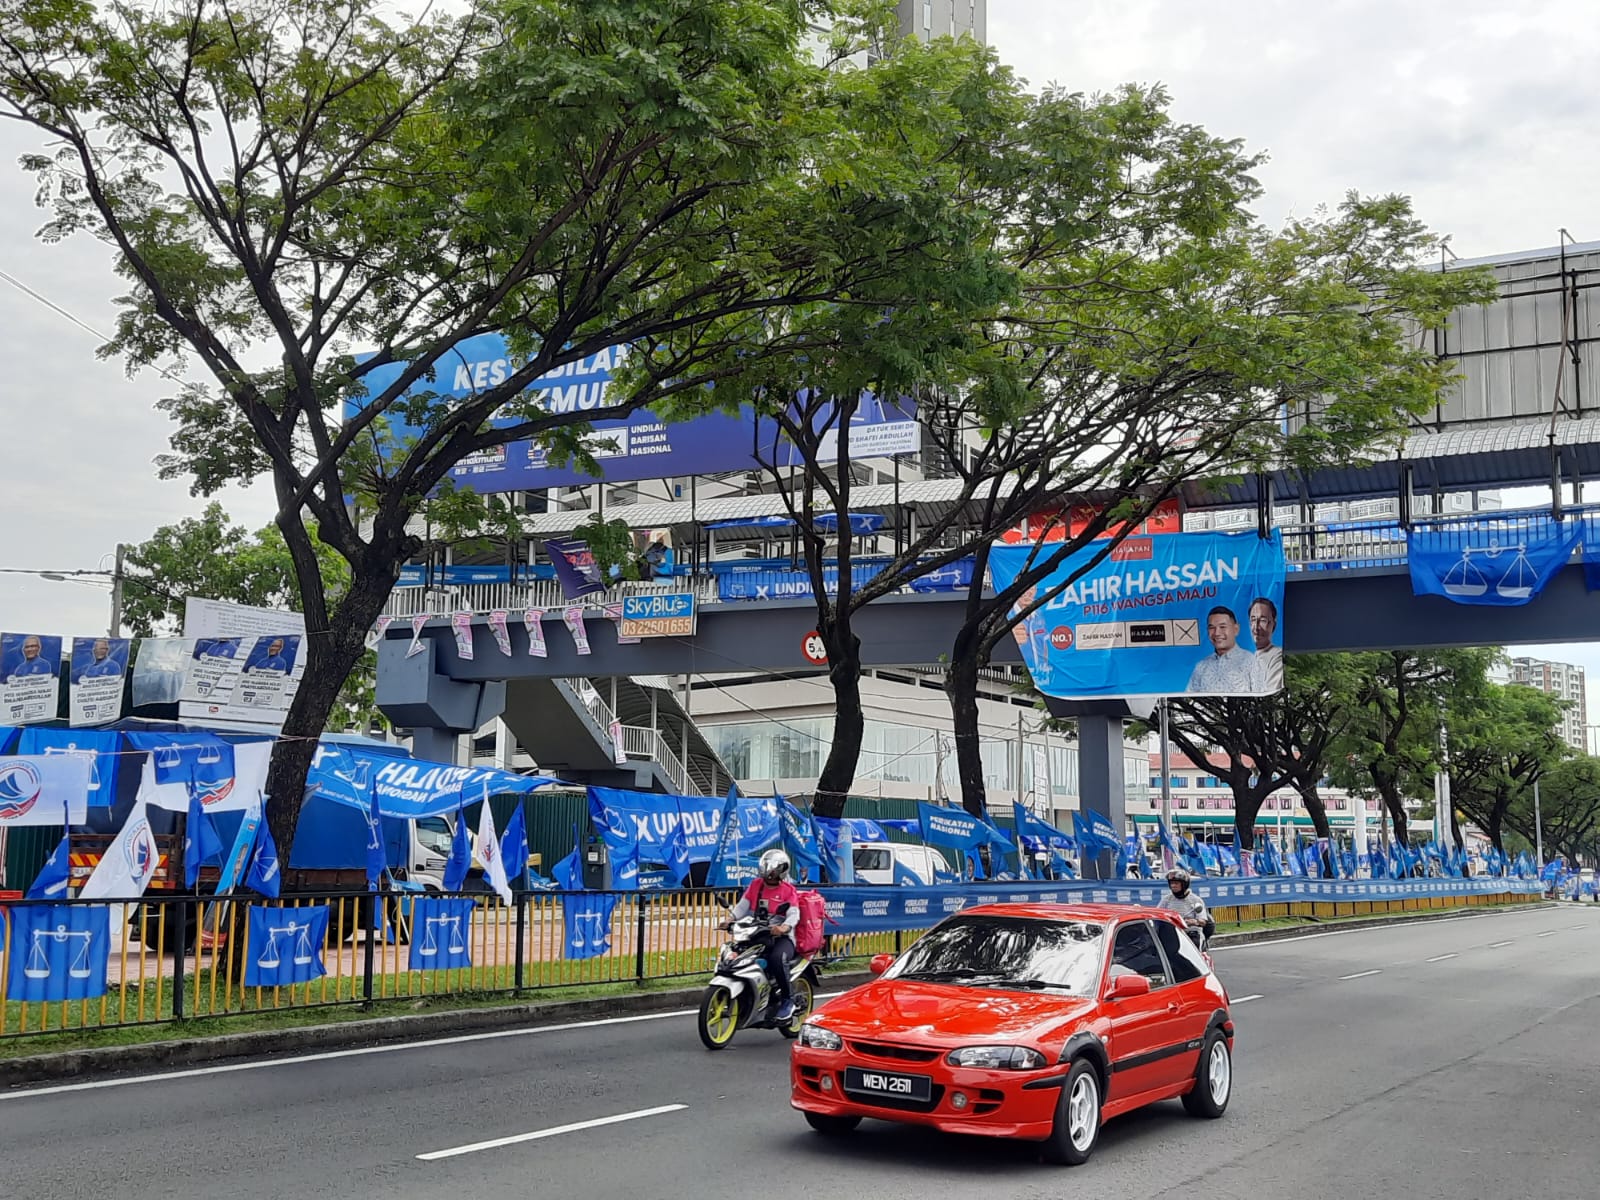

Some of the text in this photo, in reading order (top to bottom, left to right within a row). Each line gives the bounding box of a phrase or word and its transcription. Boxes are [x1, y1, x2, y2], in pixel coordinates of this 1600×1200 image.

[631, 434, 666, 445] BARISAN
[631, 445, 672, 456] NASIONAL
[1126, 557, 1238, 596] HASSAN
[1084, 586, 1217, 616] P116 WANGSA MAJU
[1052, 632, 1072, 643] NO.1
[929, 815, 975, 830] PERIKATAN
[930, 823, 972, 838] NASIONAL
[863, 1074, 912, 1093] WEN 2611
